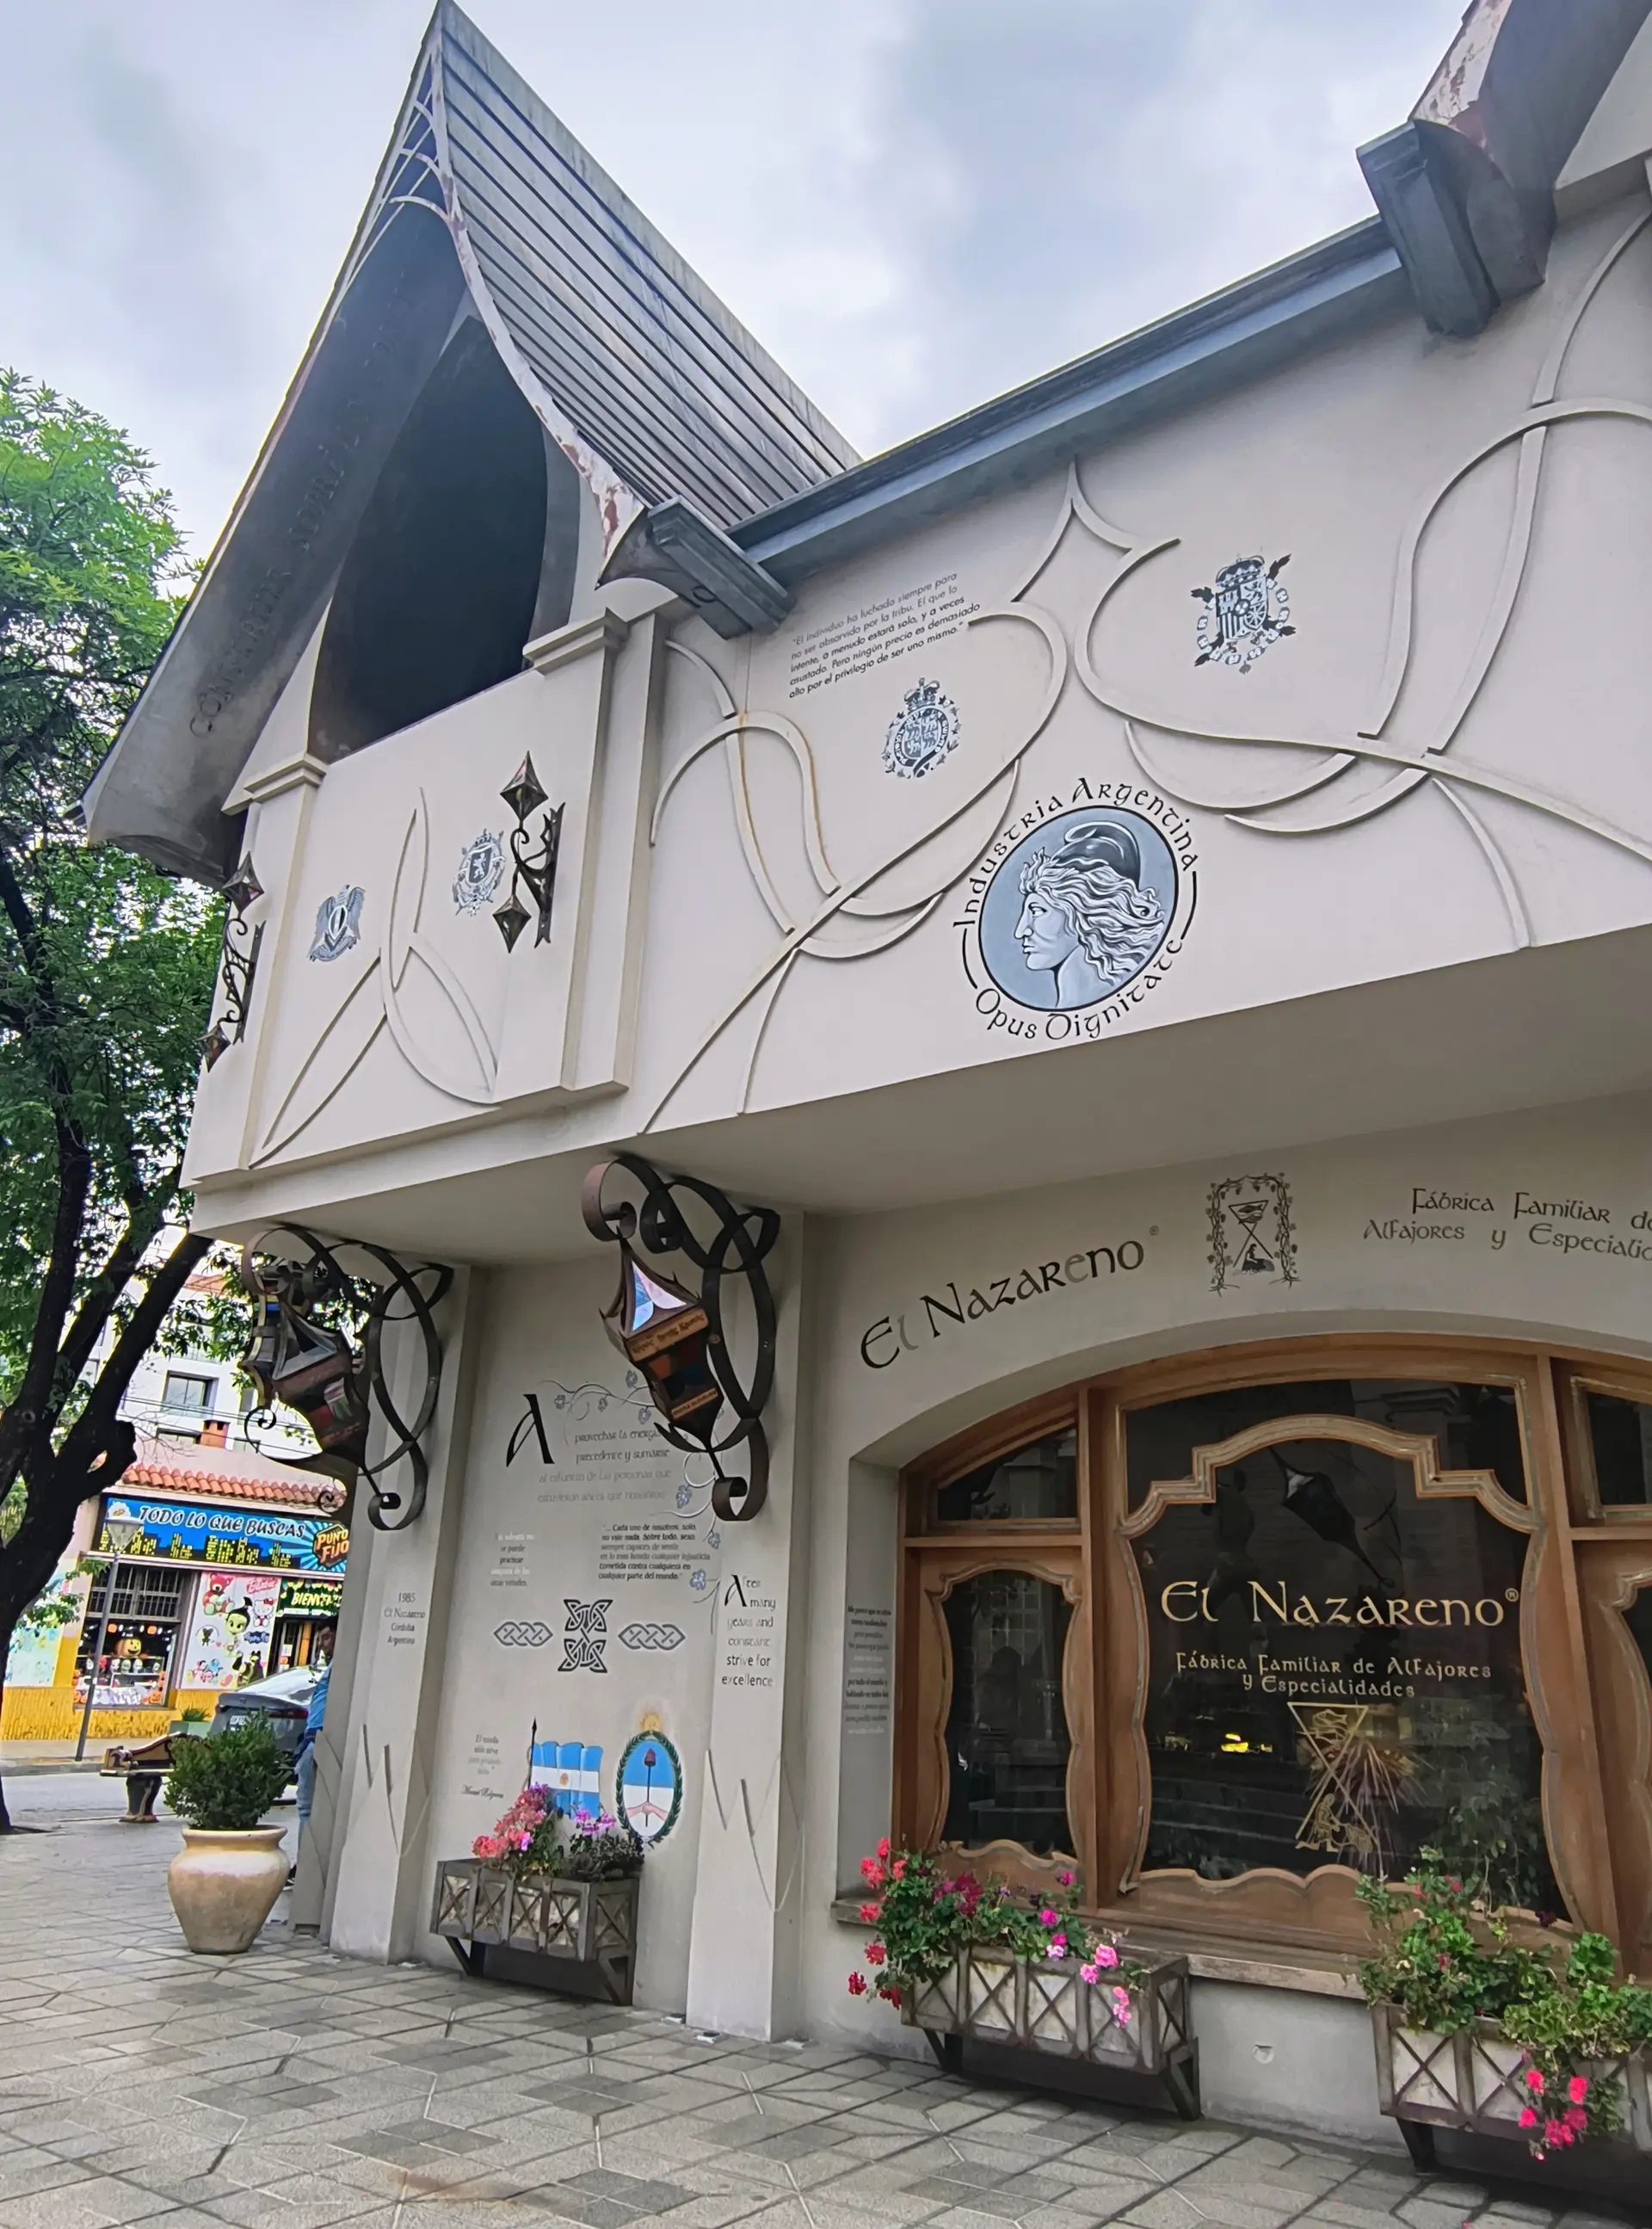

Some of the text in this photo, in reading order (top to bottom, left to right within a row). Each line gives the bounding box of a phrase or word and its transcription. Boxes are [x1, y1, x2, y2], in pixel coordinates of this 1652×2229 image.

[847, 614, 859, 625] ha
[860, 598, 895, 619] luchado
[897, 583, 933, 603] siempre
[934, 573, 958, 590] para
[792, 651, 803, 660] no
[804, 644, 817, 655] ser
[864, 619, 878, 633] por
[881, 612, 890, 623] la
[917, 596, 926, 608] El
[928, 590, 946, 604] que
[948, 585, 958, 595] lo
[831, 636, 866, 657] menudo
[867, 624, 895, 641] estará
[921, 612, 928, 622] y
[929, 608, 937, 616] a
[939, 596, 965, 611] veces
[831, 655, 851, 669] Pero
[853, 643, 883, 661] ningún
[885, 631, 913, 650] precio
[915, 626, 926, 636] es
[928, 602, 981, 630] demasiado
[807, 680, 823, 694] por
[824, 672, 833, 685] el
[835, 658, 875, 683] privilegio
[877, 652, 889, 664] de
[891, 646, 904, 658] ser
[907, 639, 925, 652] uno
[952, 777, 1199, 928] Industria Argentina
[976, 940, 1183, 1040] Opus Dignitate
[1412, 1188, 1495, 1214] Fábrica
[1513, 1191, 1611, 1223] Familiar
[1363, 1219, 1465, 1244] Alfajores
[1491, 1229, 1507, 1250] y
[860, 1315, 919, 1369] El
[139, 1507, 305, 1538] TODO LO QUE BUSCAS
[316, 1528, 349, 1551] PUNTO
[320, 1540, 349, 1564] FIJO
[1161, 1580, 1218, 1623] El
[726, 1652, 771, 1667] strive for
[1175, 1650, 1492, 1683] Fábrica Familiar de Alfajores
[721, 1673, 774, 1688] excellence
[1242, 1673, 1415, 1698] y Especialidades
